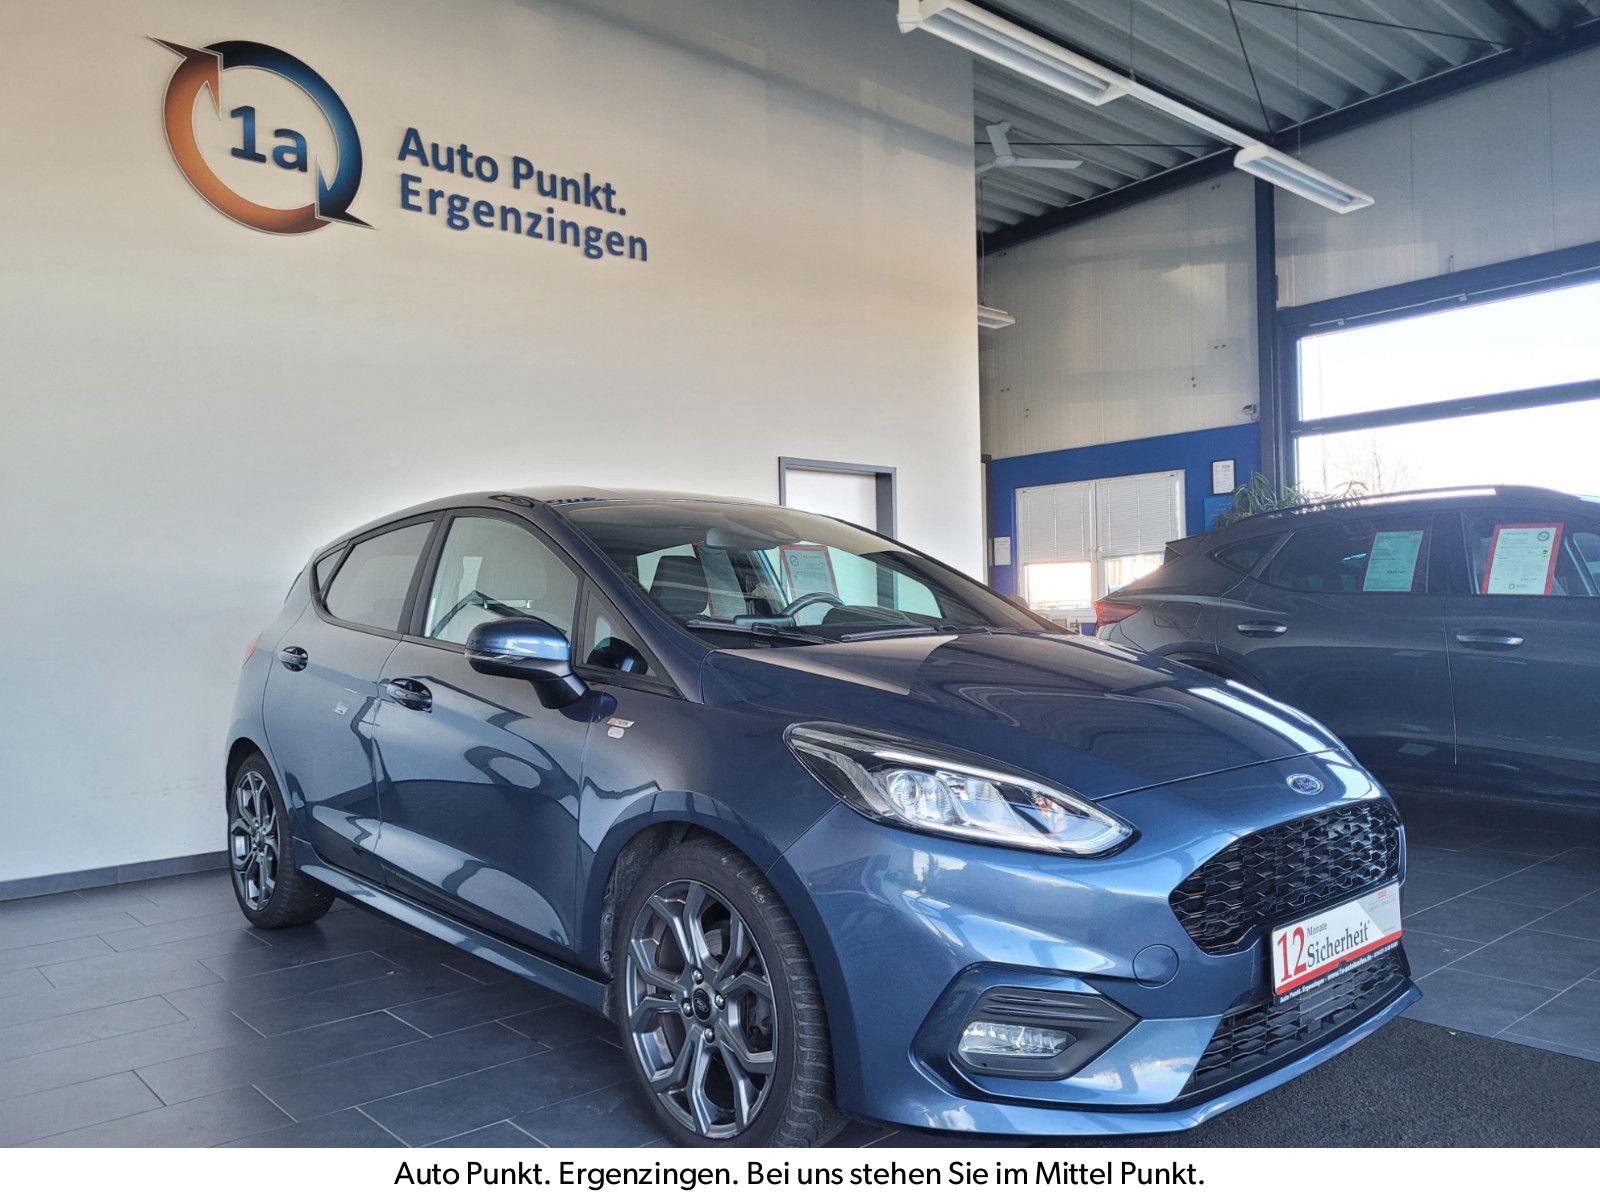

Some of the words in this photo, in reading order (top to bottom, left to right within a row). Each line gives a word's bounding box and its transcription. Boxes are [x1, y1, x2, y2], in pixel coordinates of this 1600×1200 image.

[229, 105, 309, 172] 1a
[398, 127, 500, 183] Auto
[512, 155, 628, 216] Punkt.
[400, 174, 648, 261] Ergenzingen
[1277, 926, 1307, 982] 12
